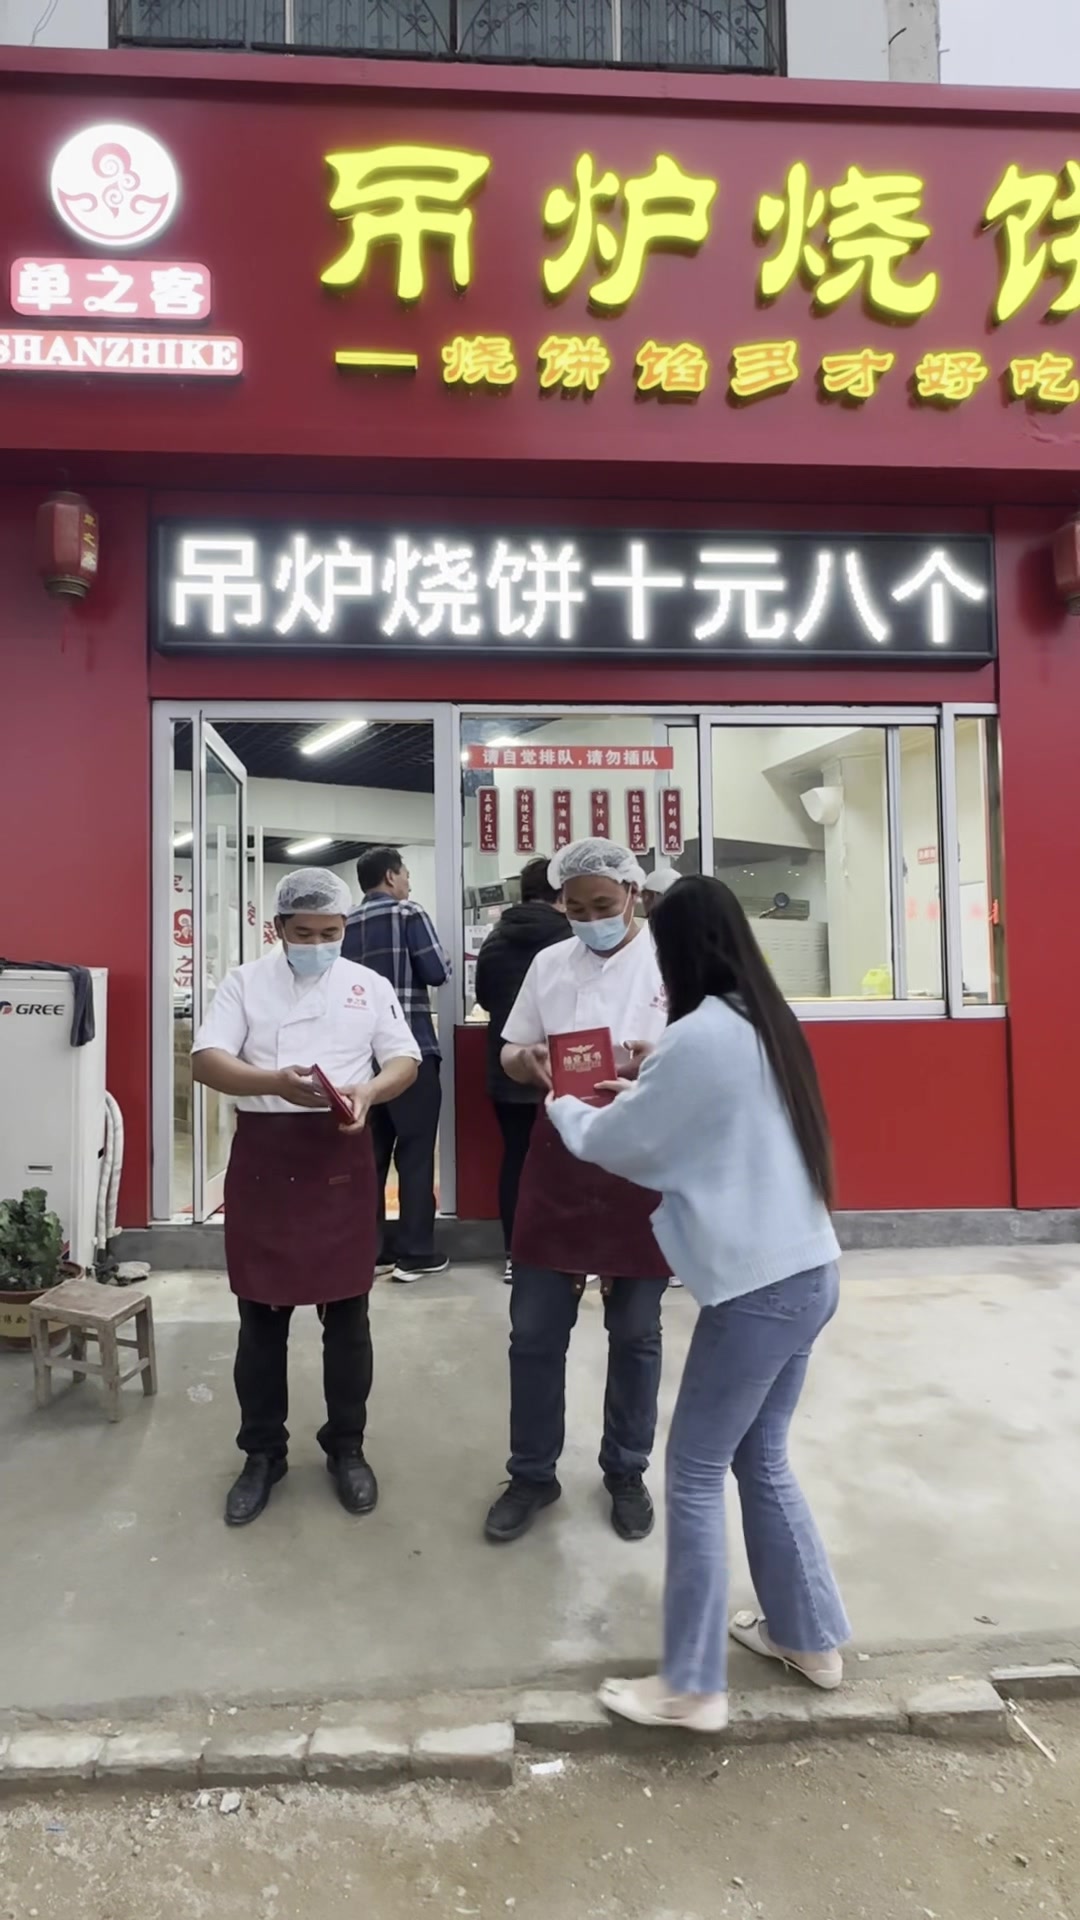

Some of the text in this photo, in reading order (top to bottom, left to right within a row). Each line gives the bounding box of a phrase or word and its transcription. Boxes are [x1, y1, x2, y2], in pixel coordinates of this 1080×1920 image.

[17, 262, 205, 315] 单之客
[172, 532, 987, 645] 吊炉烧饼十元八个
[16, 1003, 65, 1016] GREE
